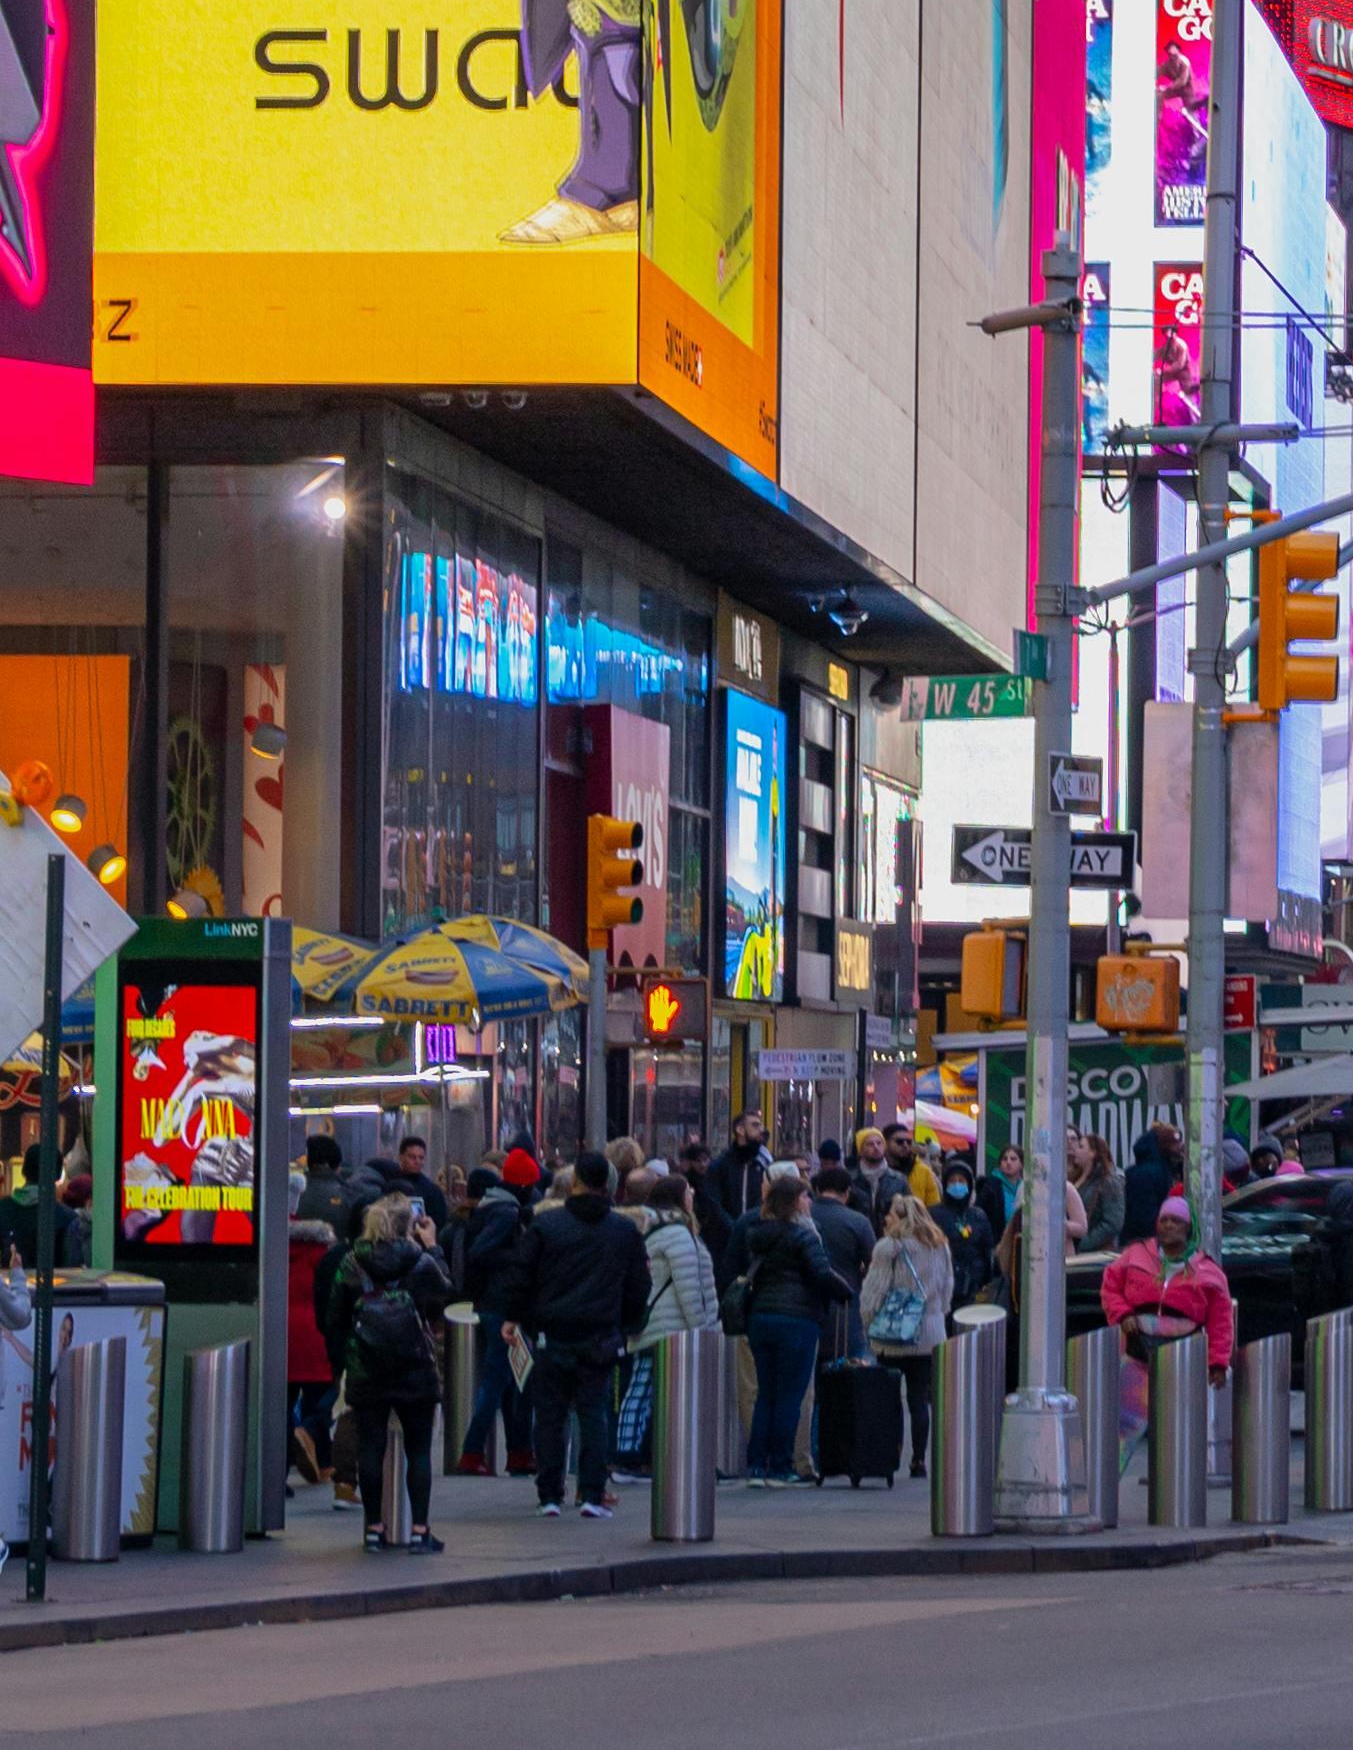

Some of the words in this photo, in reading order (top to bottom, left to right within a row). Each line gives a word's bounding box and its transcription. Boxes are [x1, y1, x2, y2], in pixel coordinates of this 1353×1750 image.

[932, 680, 955, 714] W
[967, 677, 996, 711] 45
[1055, 768, 1072, 796] ONE
[1078, 771, 1096, 797] WAY
[980, 838, 1032, 871] ONE
[360, 996, 473, 1017] SABRETT
[140, 1093, 237, 1148] MADONNA
